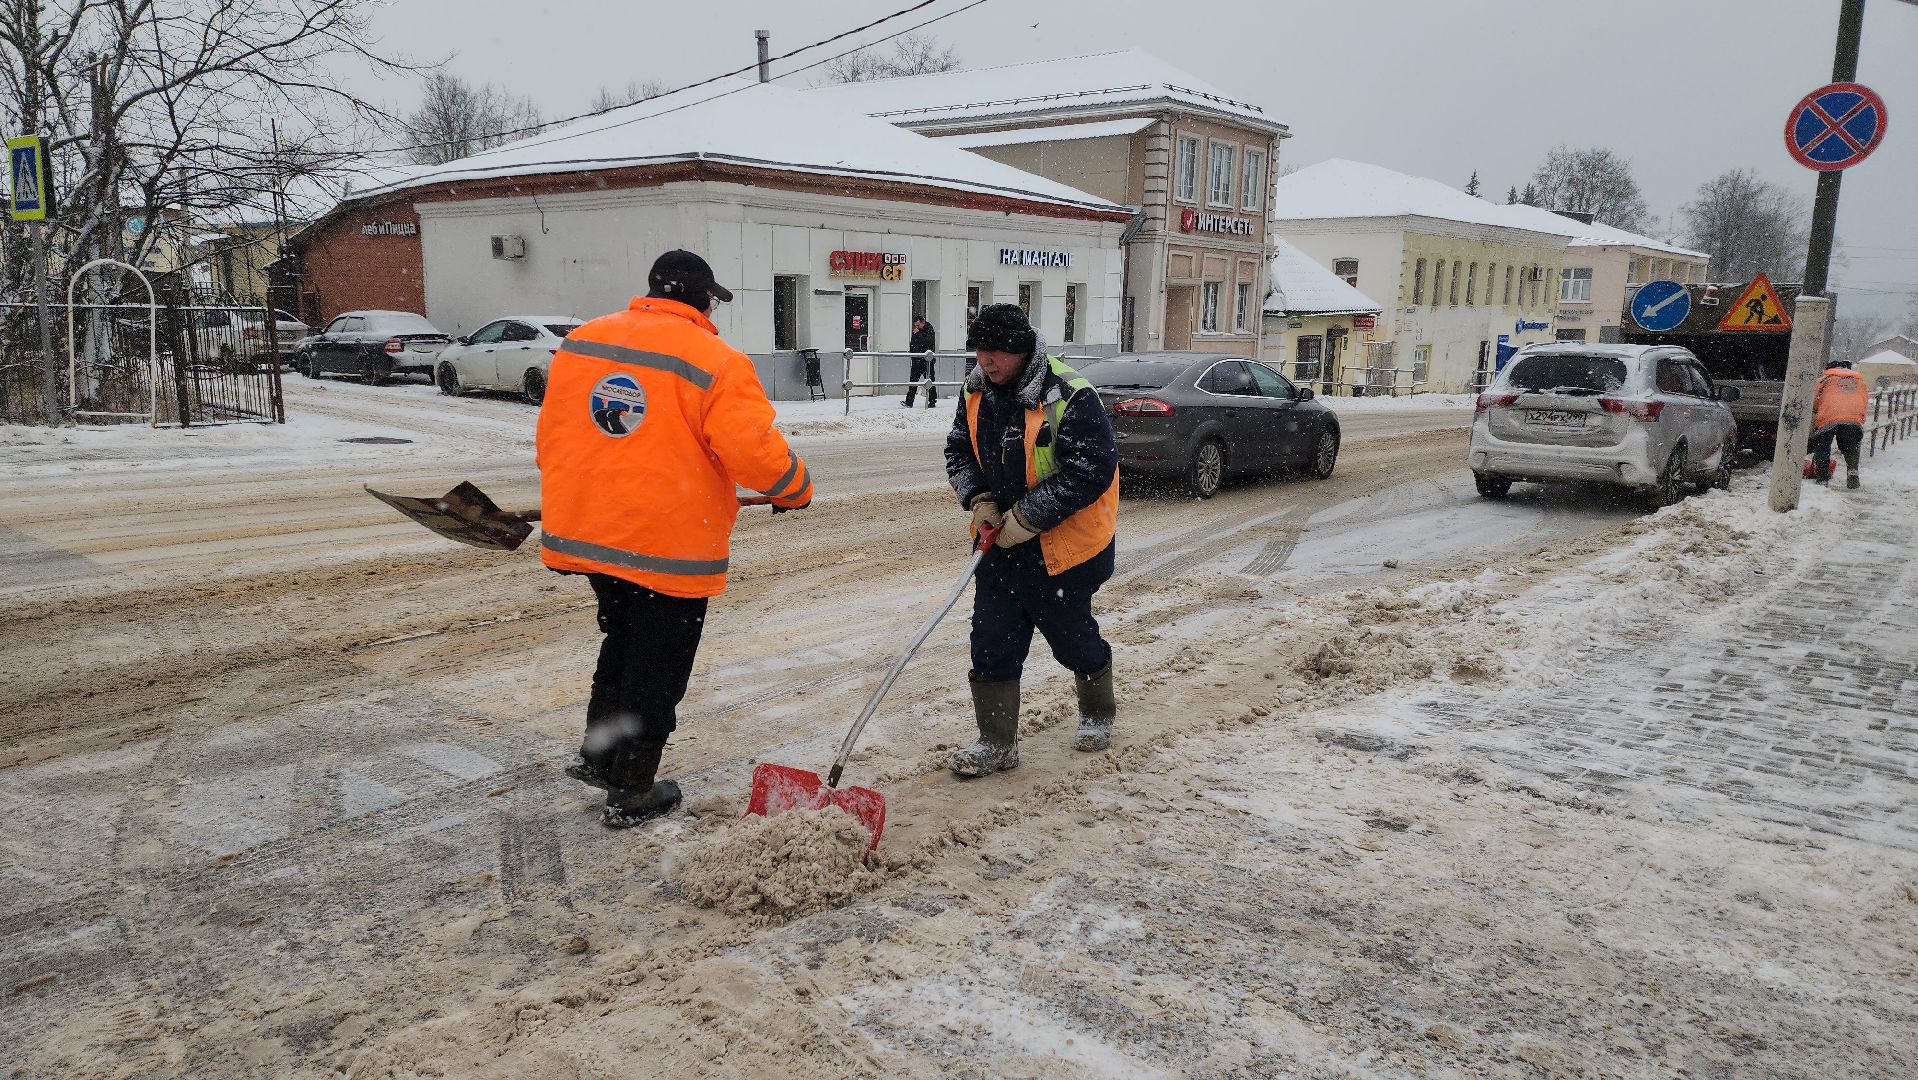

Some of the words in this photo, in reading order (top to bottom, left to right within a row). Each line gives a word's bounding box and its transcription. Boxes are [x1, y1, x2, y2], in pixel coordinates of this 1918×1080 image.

[385, 221, 416, 237] Пицца
[1197, 212, 1255, 235] ИНТЕРСЕТЬ
[830, 250, 883, 271] СУШИ
[1000, 248, 1020, 265] НА
